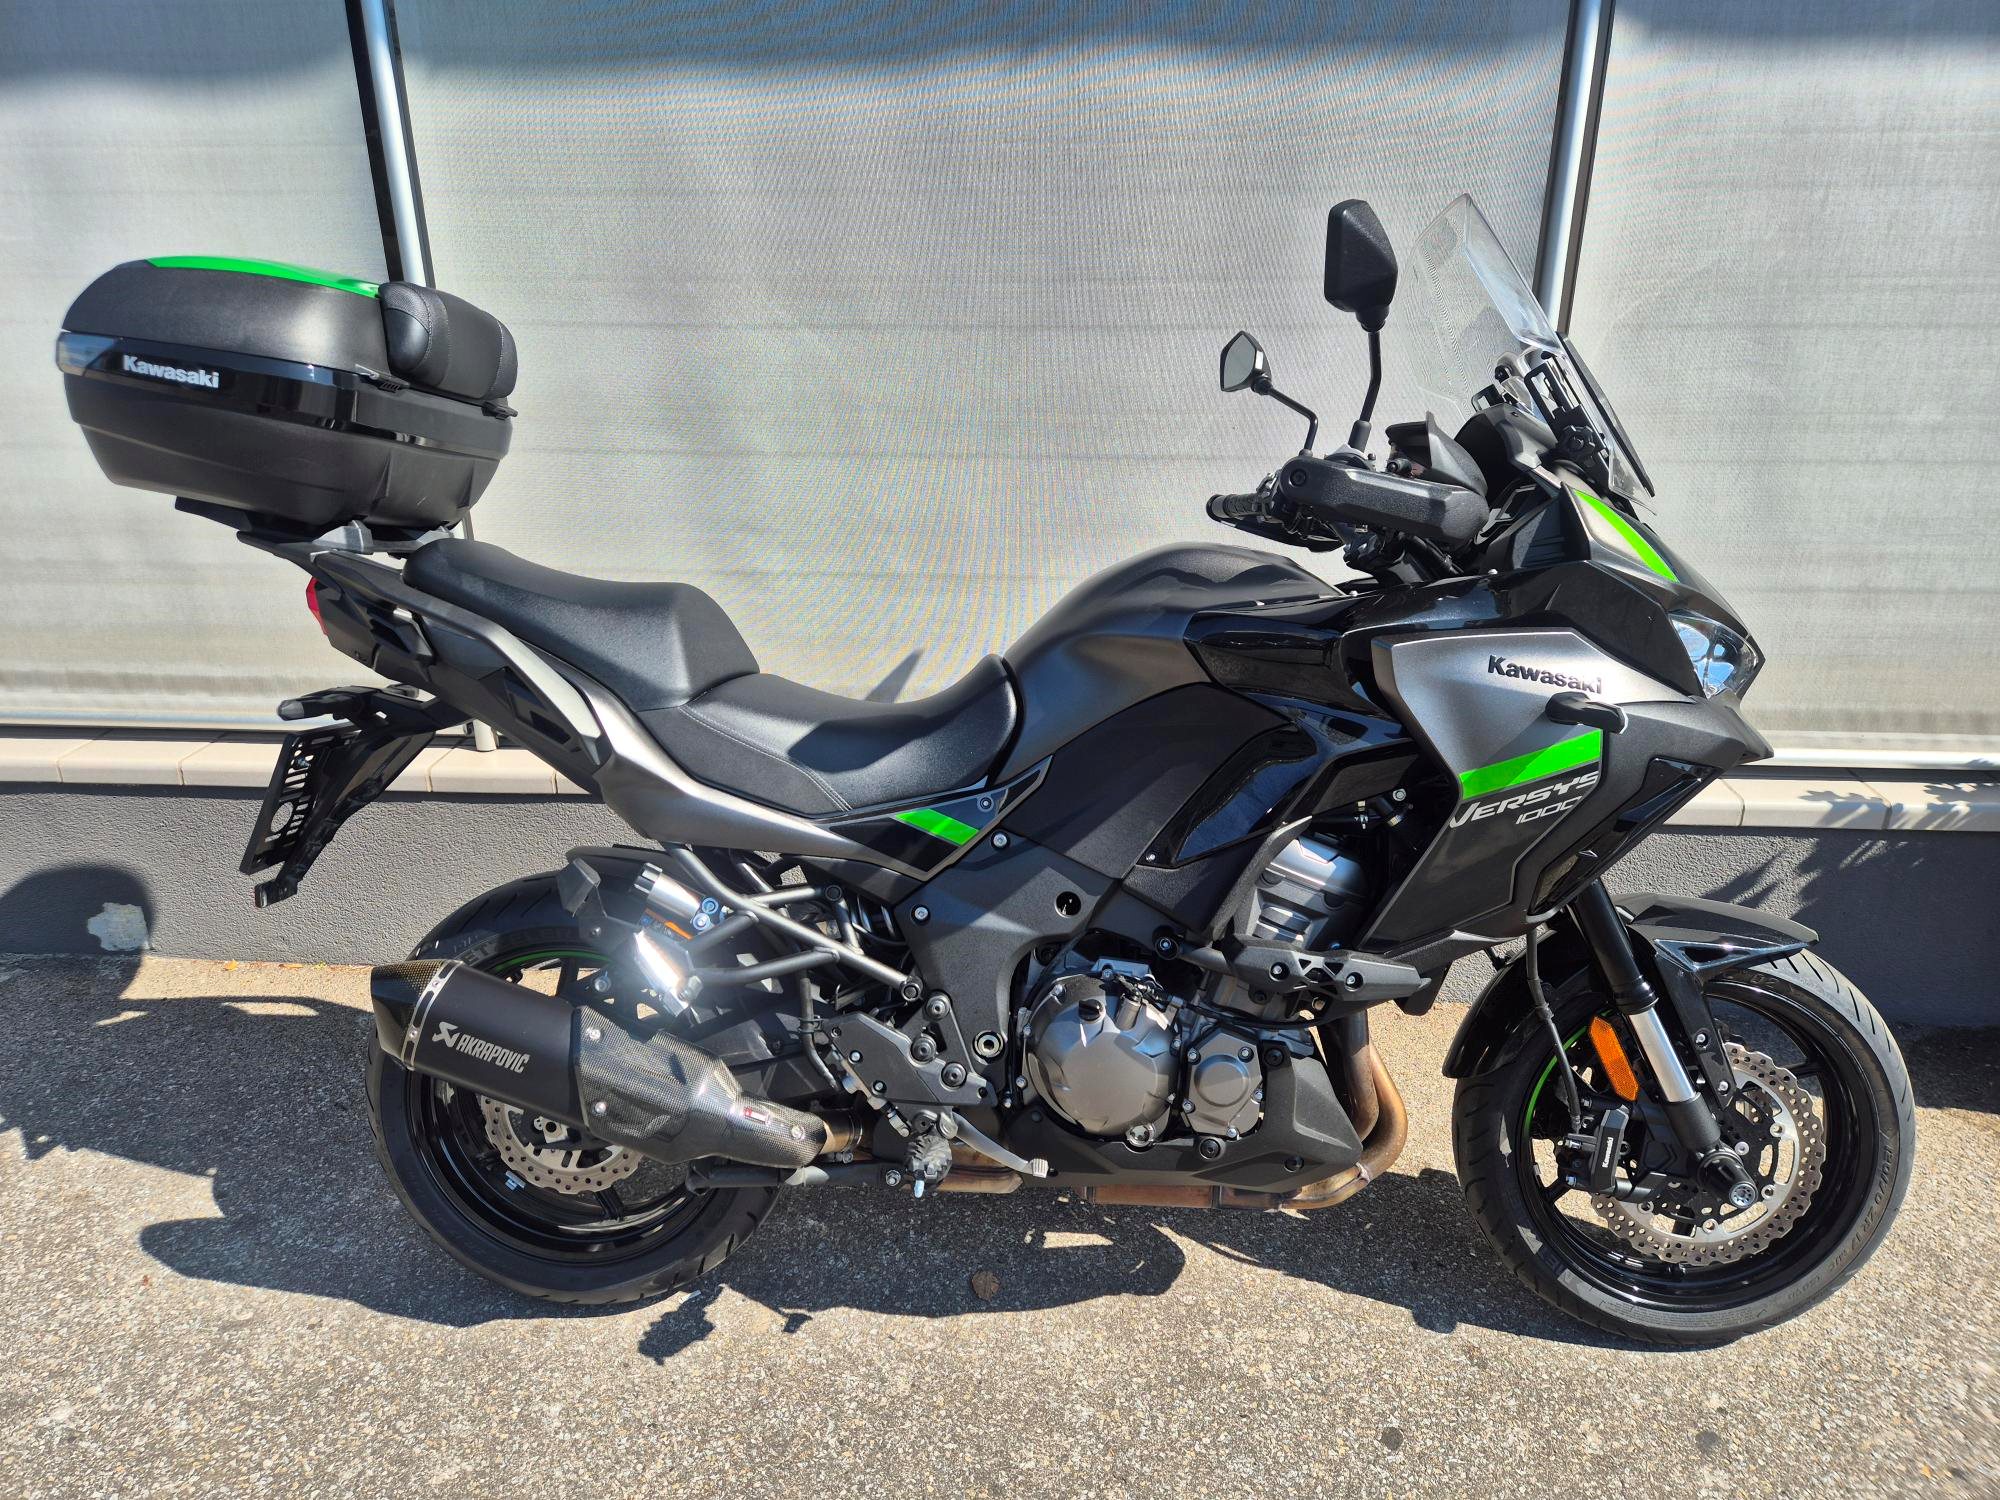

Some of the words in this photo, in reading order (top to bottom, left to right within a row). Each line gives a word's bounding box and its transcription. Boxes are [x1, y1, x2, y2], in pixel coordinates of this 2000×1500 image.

[123, 354, 220, 389] Kawasaki
[1487, 654, 1602, 694] Kawasaki
[1450, 770, 1600, 829] VERSYS
